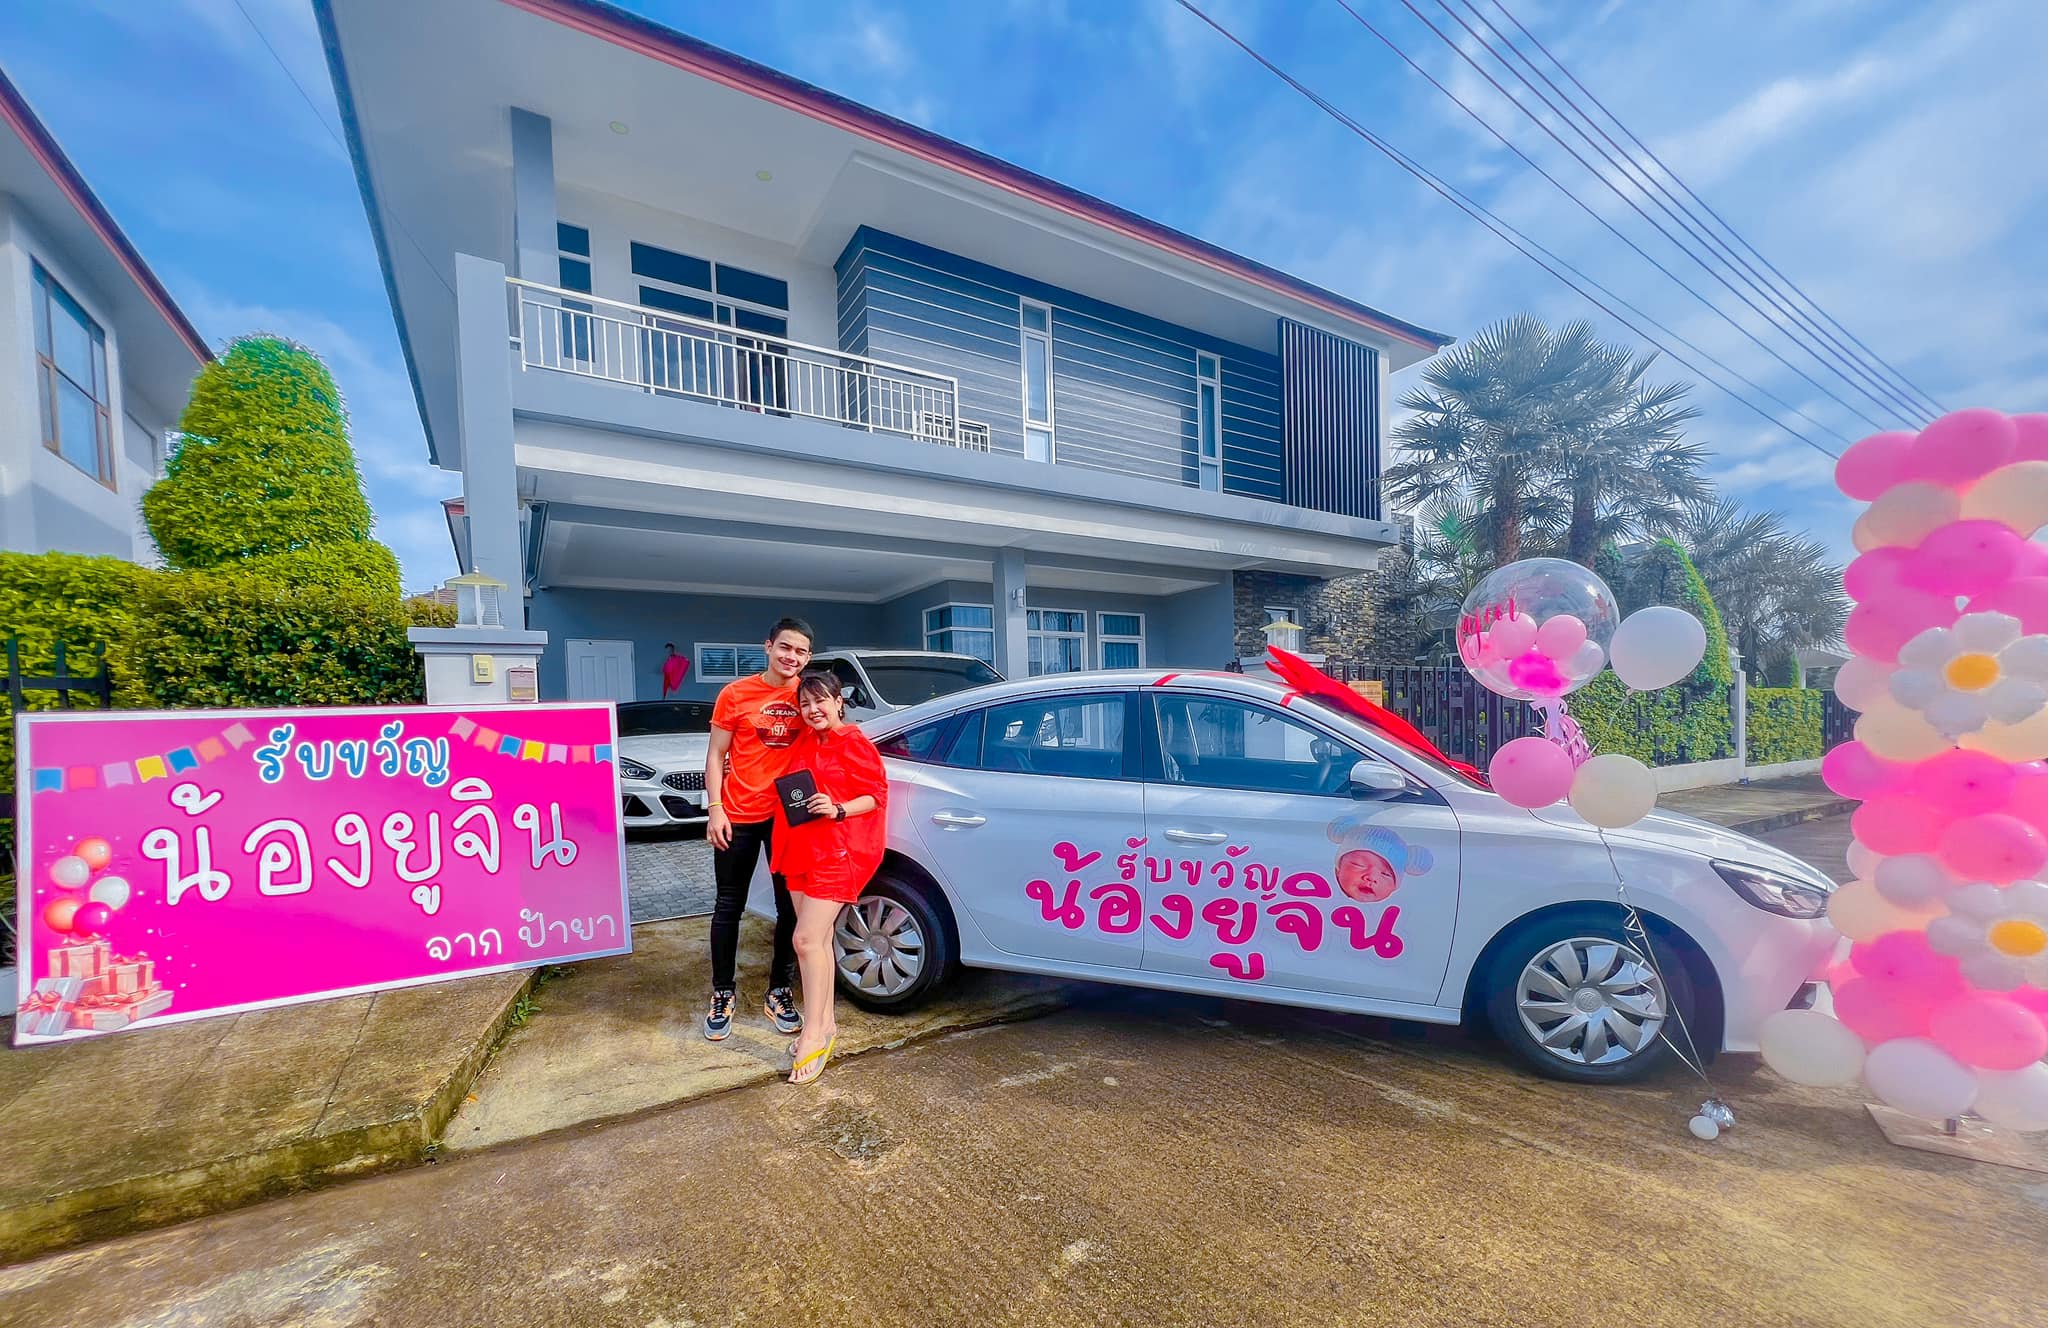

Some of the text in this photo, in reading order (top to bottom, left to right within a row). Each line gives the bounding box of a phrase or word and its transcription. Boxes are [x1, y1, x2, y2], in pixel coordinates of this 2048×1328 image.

[775, 709, 797, 717] JEANS
[254, 720, 450, 787] รับขวัญ
[142, 778, 578, 915] น้องยูจิน
[1117, 837, 1280, 901] รับขวัญ
[425, 907, 616, 961] จาก ป้ายา
[1026, 841, 1404, 981] น้องยูจิน
